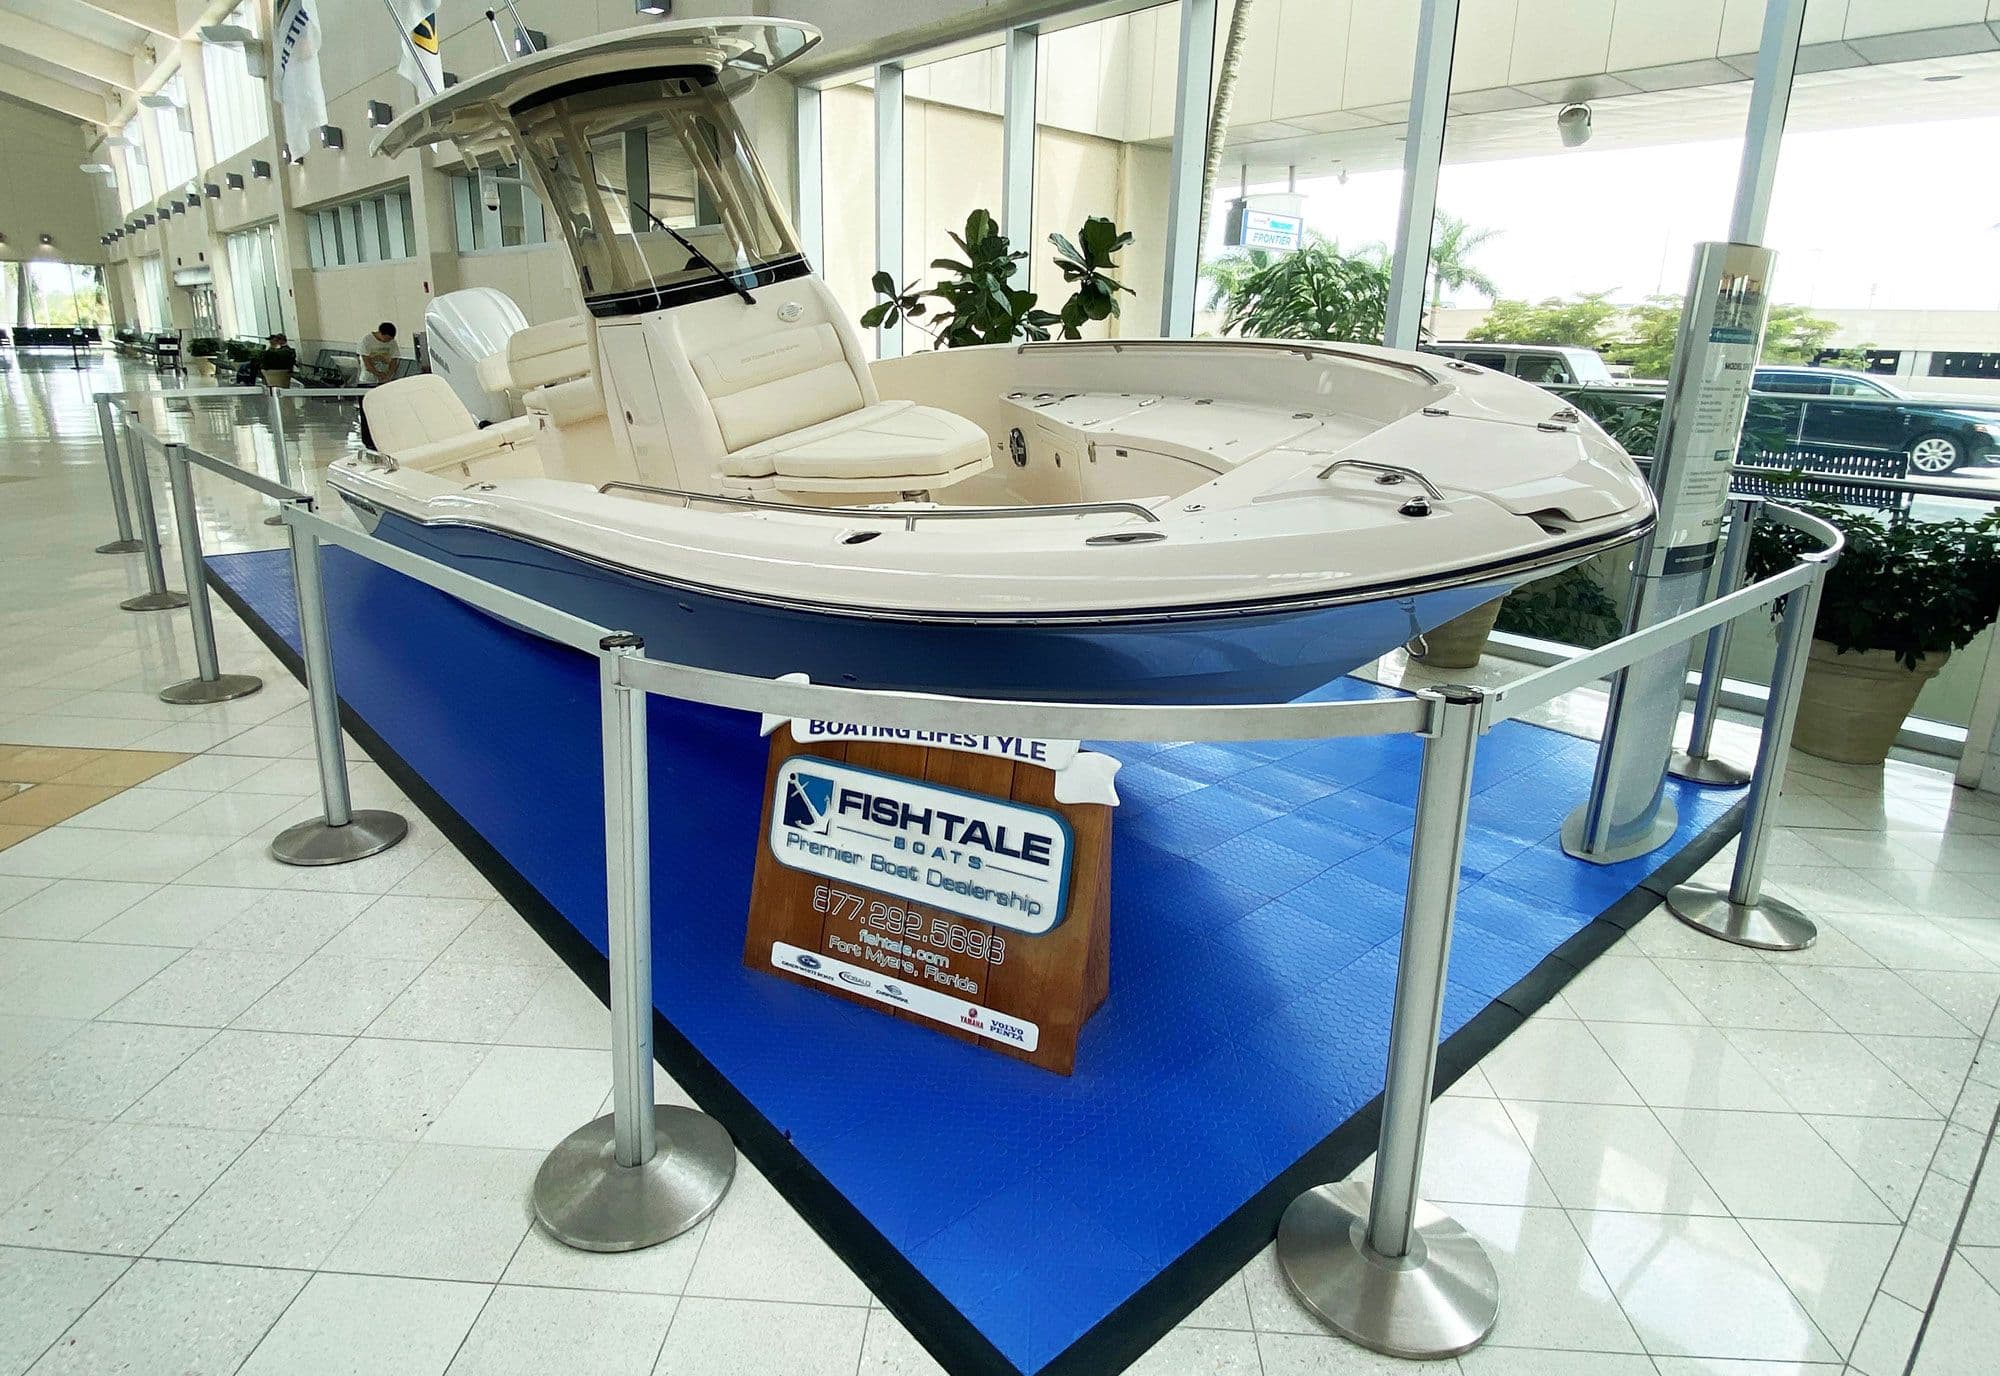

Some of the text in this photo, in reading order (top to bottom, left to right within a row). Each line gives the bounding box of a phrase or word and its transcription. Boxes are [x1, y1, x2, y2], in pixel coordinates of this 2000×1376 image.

[1253, 232, 1292, 245] FRONTIER
[893, 836, 982, 869] BOATS
[786, 831, 1042, 918] Premier Boat Dealership
[812, 885, 1006, 966] 877.292.5698
[828, 934, 979, 994] Fort Myers, Florida
[858, 928, 950, 968] fishtale.com
[960, 1015, 984, 1030] YAMAHA
[989, 1025, 1025, 1042] PENTA
[990, 1019, 1024, 1035] VOLVO
